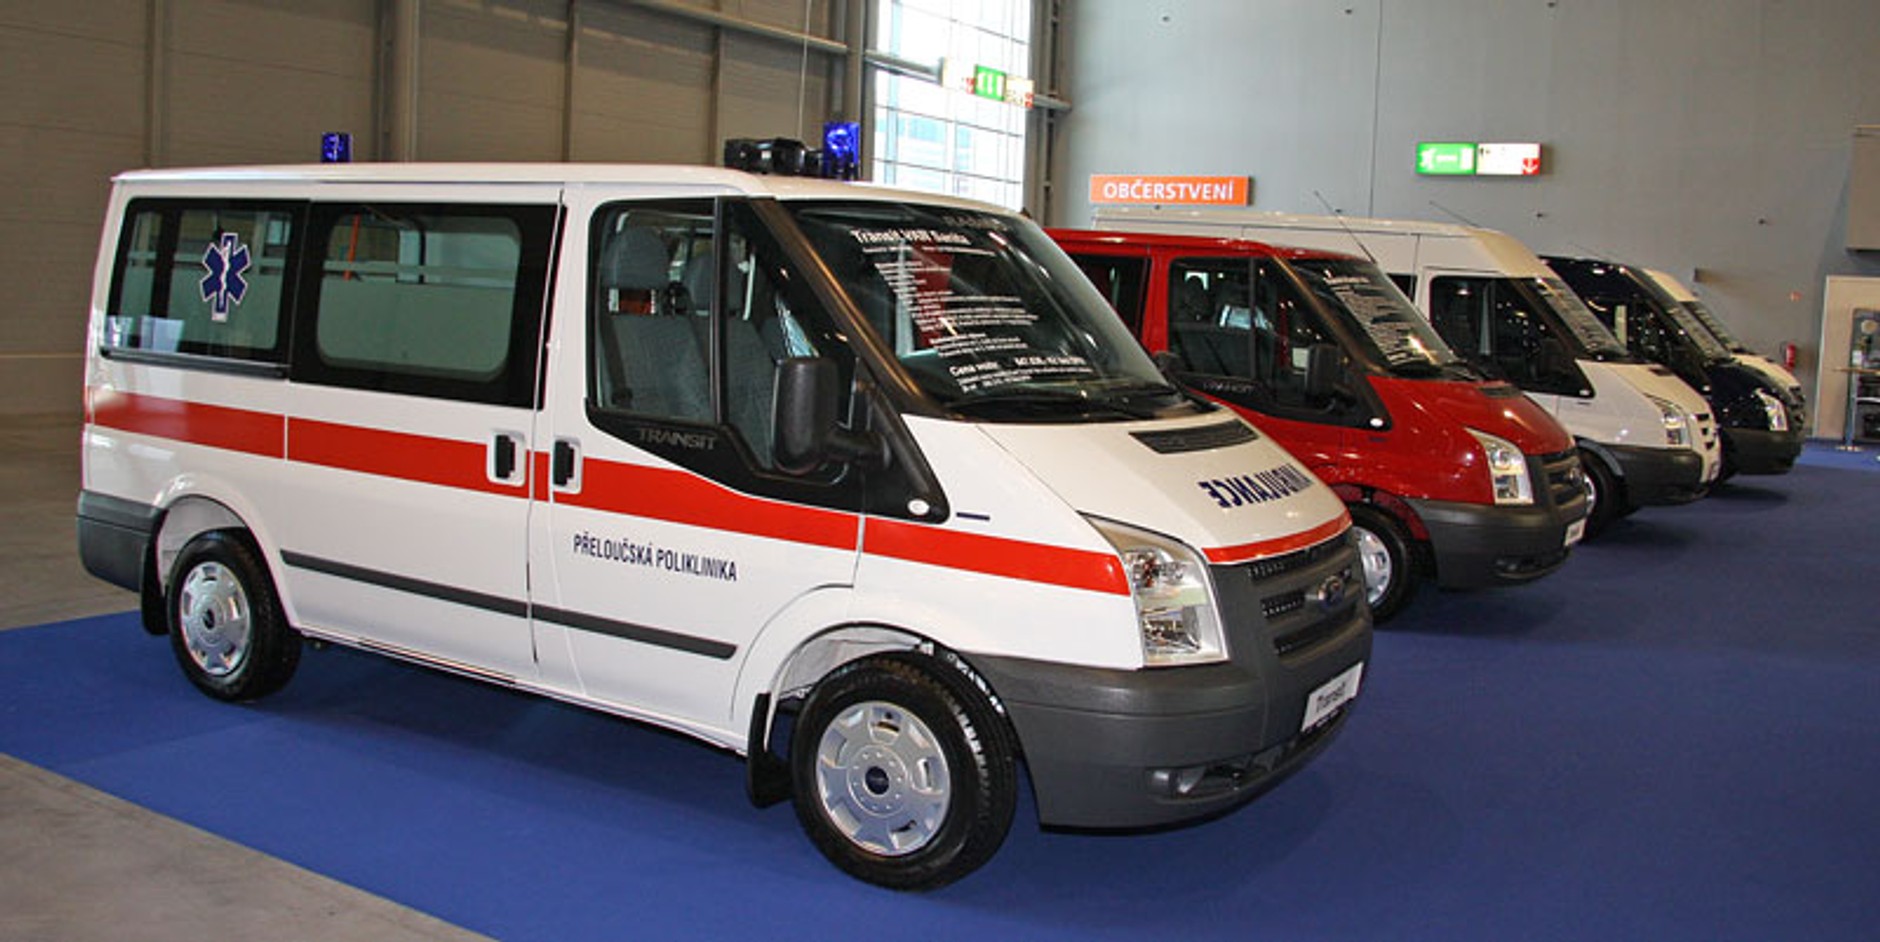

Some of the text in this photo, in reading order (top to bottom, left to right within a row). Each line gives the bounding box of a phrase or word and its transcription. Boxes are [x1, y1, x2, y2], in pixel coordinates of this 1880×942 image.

[1103, 179, 1234, 200] OBČERSTVENÍ
[639, 428, 717, 450] TRANSIT
[573, 531, 738, 582] PŘELOUČSKÁ POLIKLINIKA
